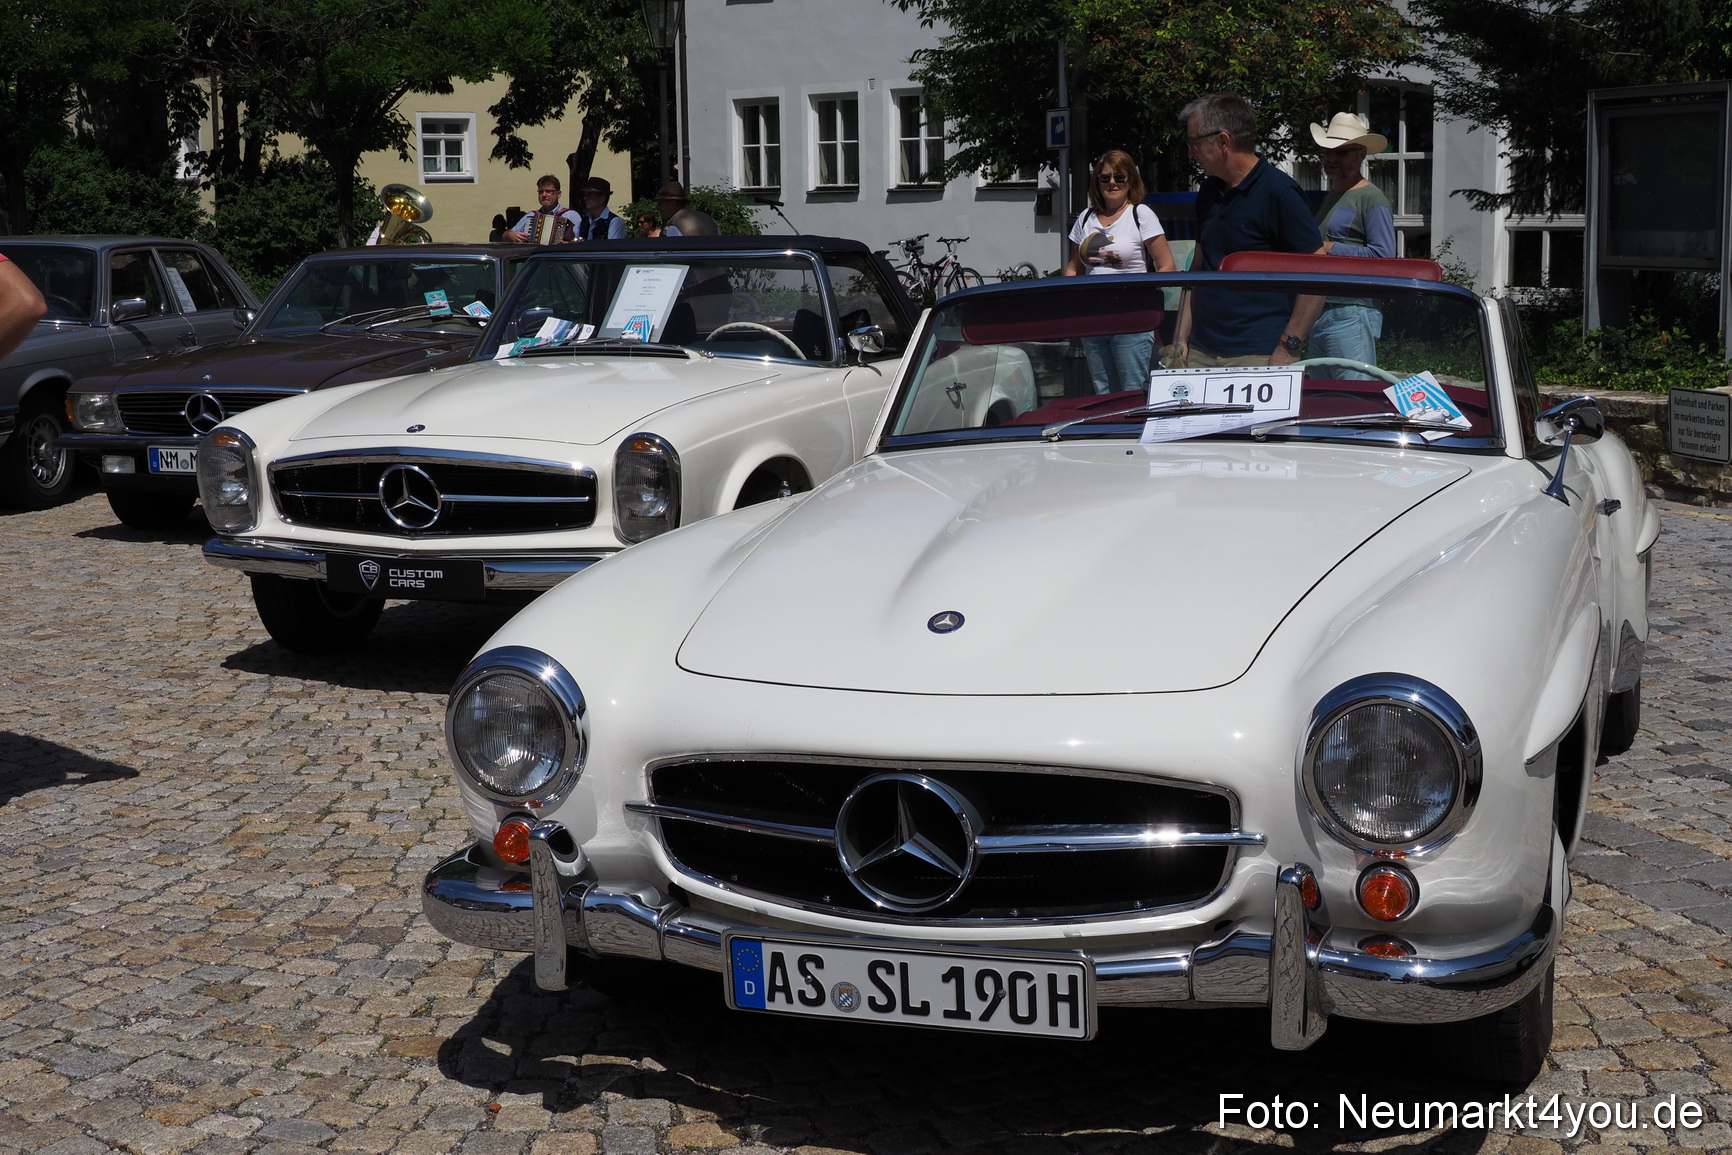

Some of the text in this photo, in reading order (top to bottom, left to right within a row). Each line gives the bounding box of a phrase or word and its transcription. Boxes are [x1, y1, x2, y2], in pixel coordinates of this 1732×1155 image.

[1223, 383, 1273, 403] 110
[1674, 396, 1725, 412] Aufenthalt und Parken
[1681, 413, 1705, 424] markierten
[1707, 415, 1725, 427] Bereich
[1694, 428, 1721, 442] berechtigte
[1679, 438, 1698, 450] Personen
[1700, 443, 1717, 454] erlaubt
[160, 451, 179, 469] NM
[389, 569, 443, 579] CUSTOM
[389, 579, 425, 588] CARS
[744, 980, 756, 995] D
[766, 951, 826, 1007] AS
[867, 959, 931, 1017] SL
[942, 966, 1080, 1029] 190H
